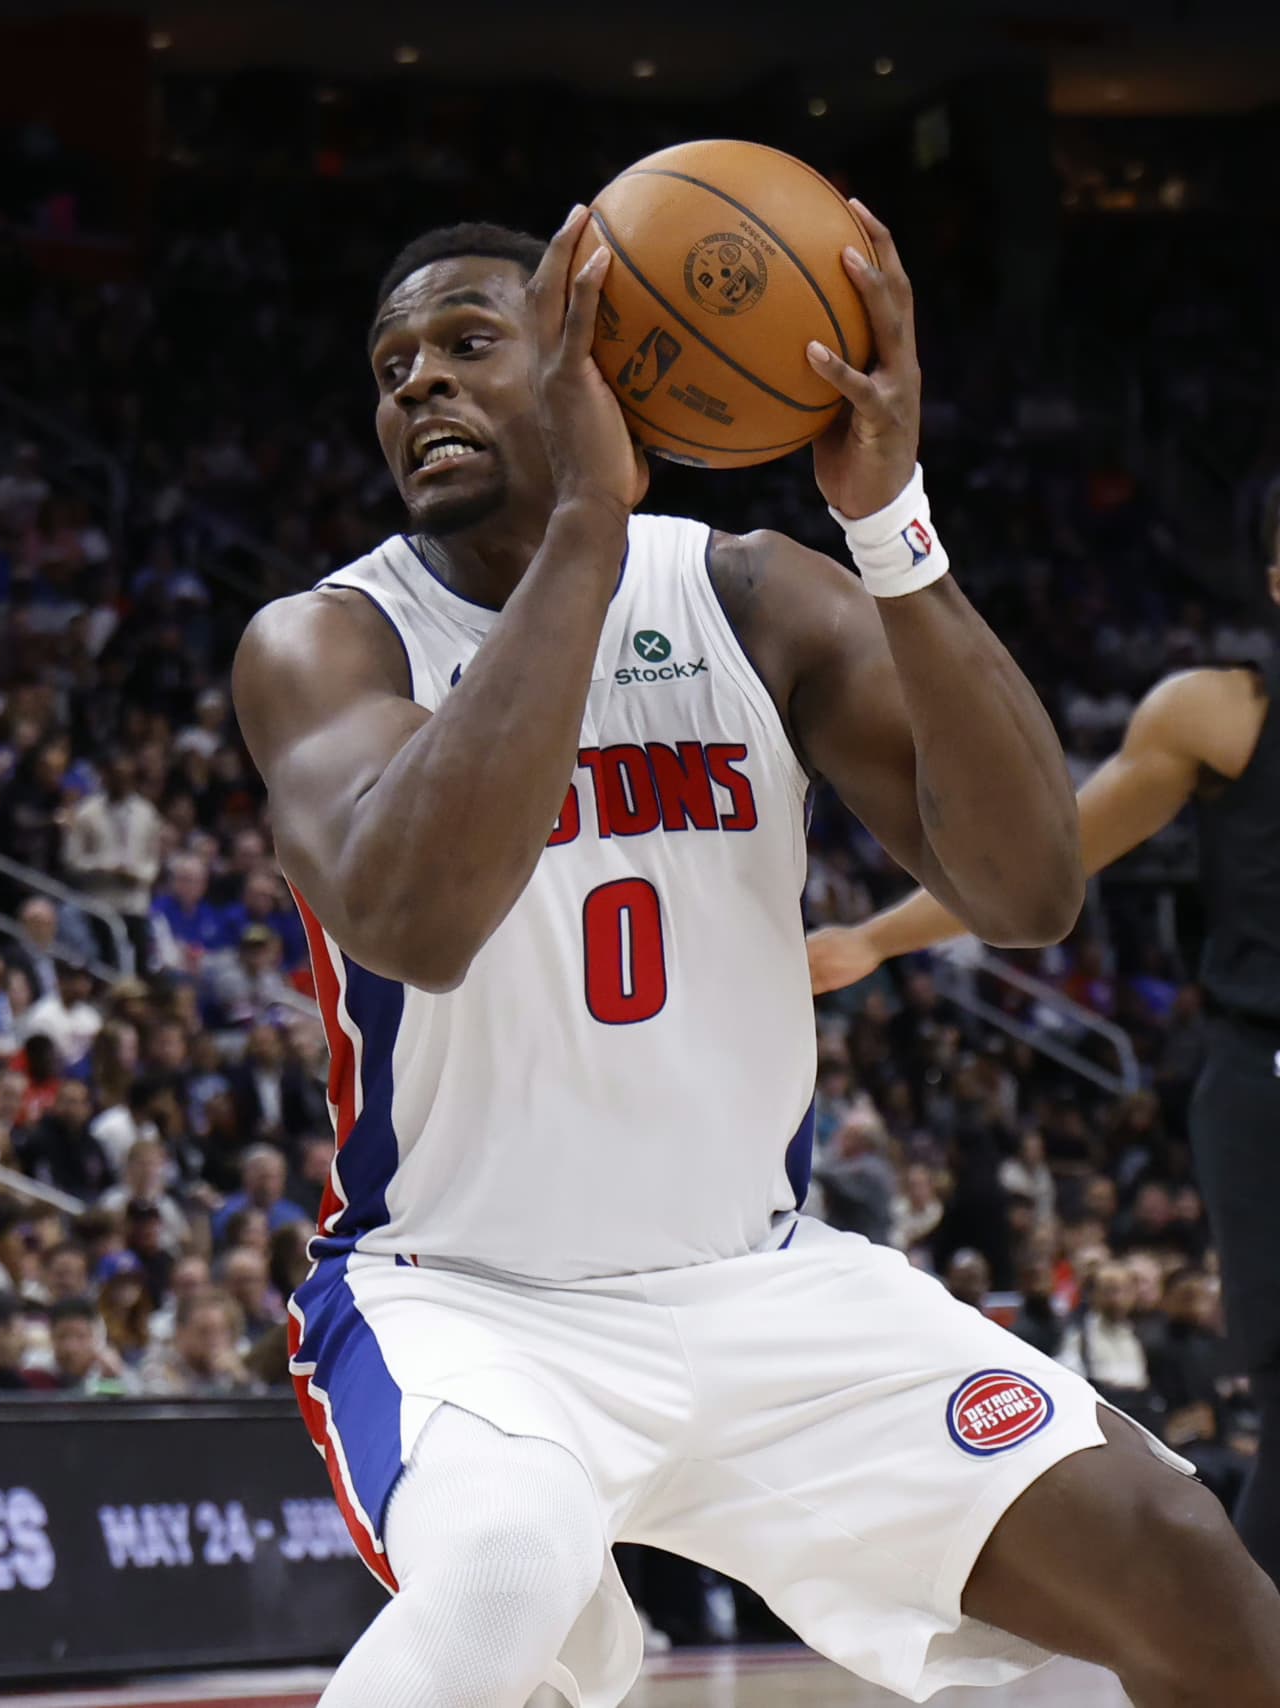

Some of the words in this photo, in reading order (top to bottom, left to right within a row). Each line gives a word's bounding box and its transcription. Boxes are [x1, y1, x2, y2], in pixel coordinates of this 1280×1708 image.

[614, 656, 709, 686] StockX
[582, 877, 667, 1025] 0
[963, 1386, 1027, 1423] DETROIT
[970, 1397, 1035, 1435] PISTONS
[98, 1503, 193, 1568] MAY
